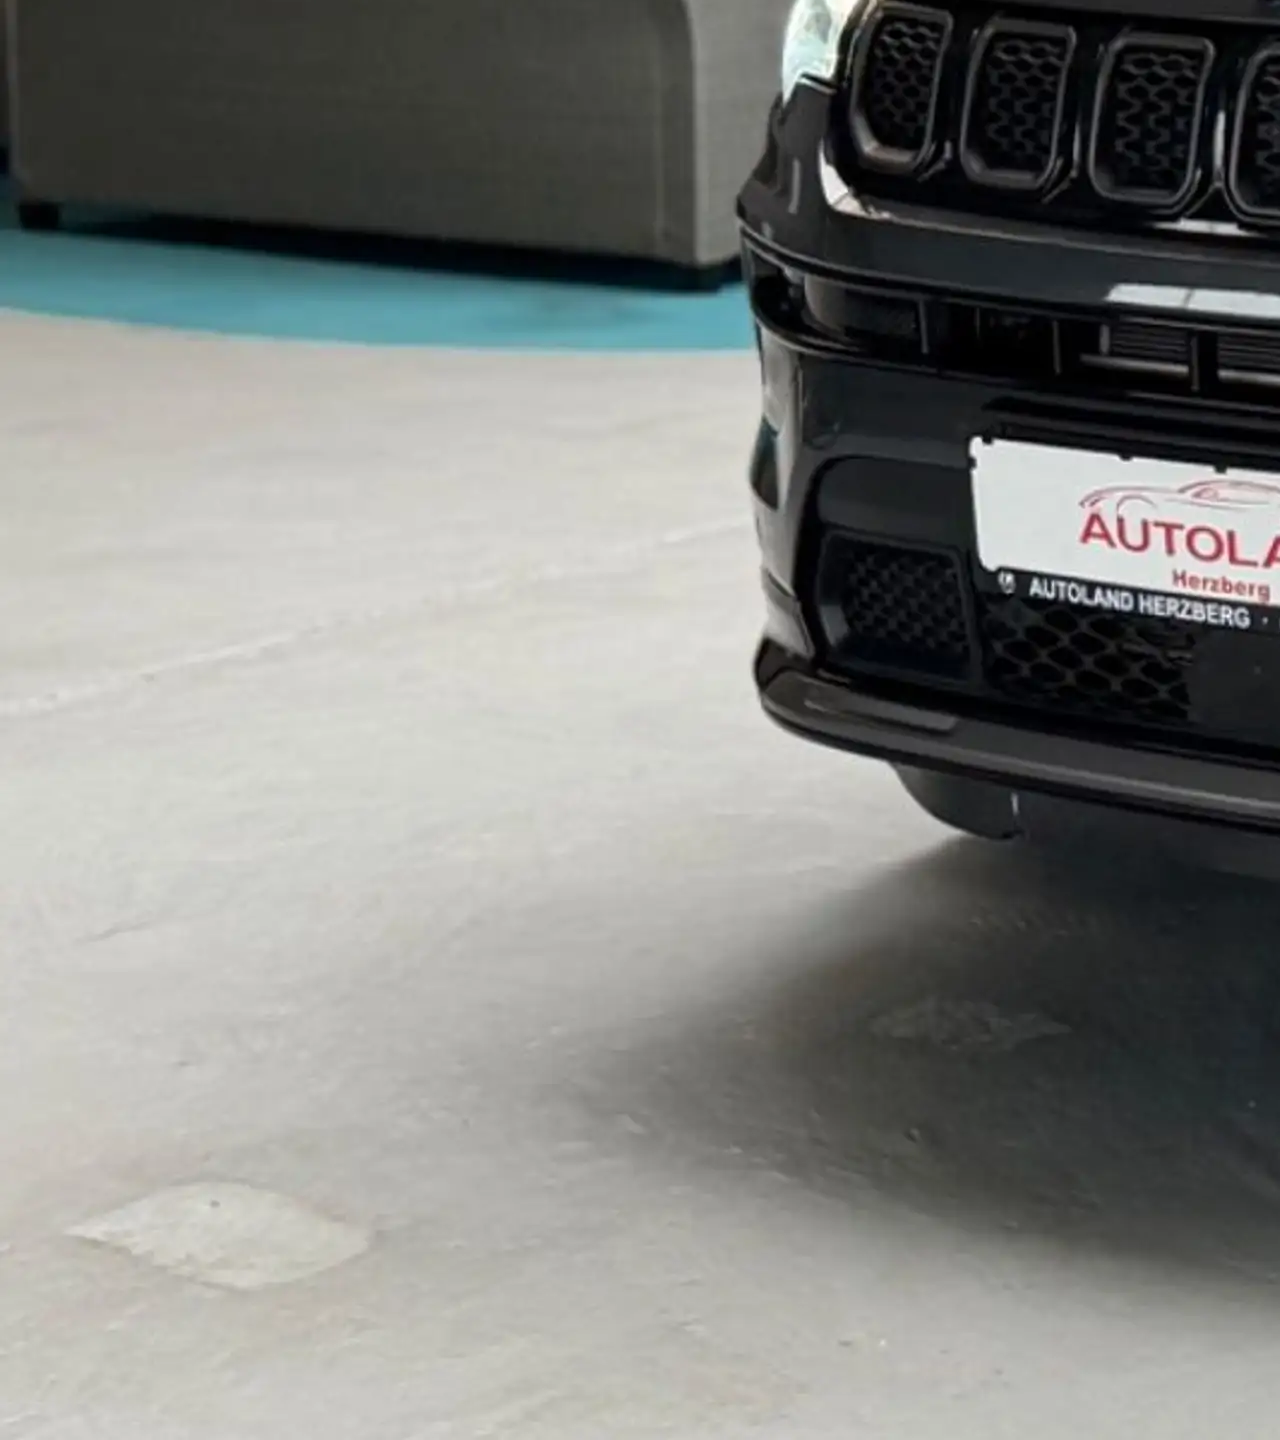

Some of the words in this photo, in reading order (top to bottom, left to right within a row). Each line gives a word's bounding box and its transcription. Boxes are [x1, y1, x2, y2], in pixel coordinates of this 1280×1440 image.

[1029, 577, 1134, 611] AUTOLAND
[1139, 592, 1251, 629] HERZBERG
[1172, 569, 1271, 603] Herzberg
